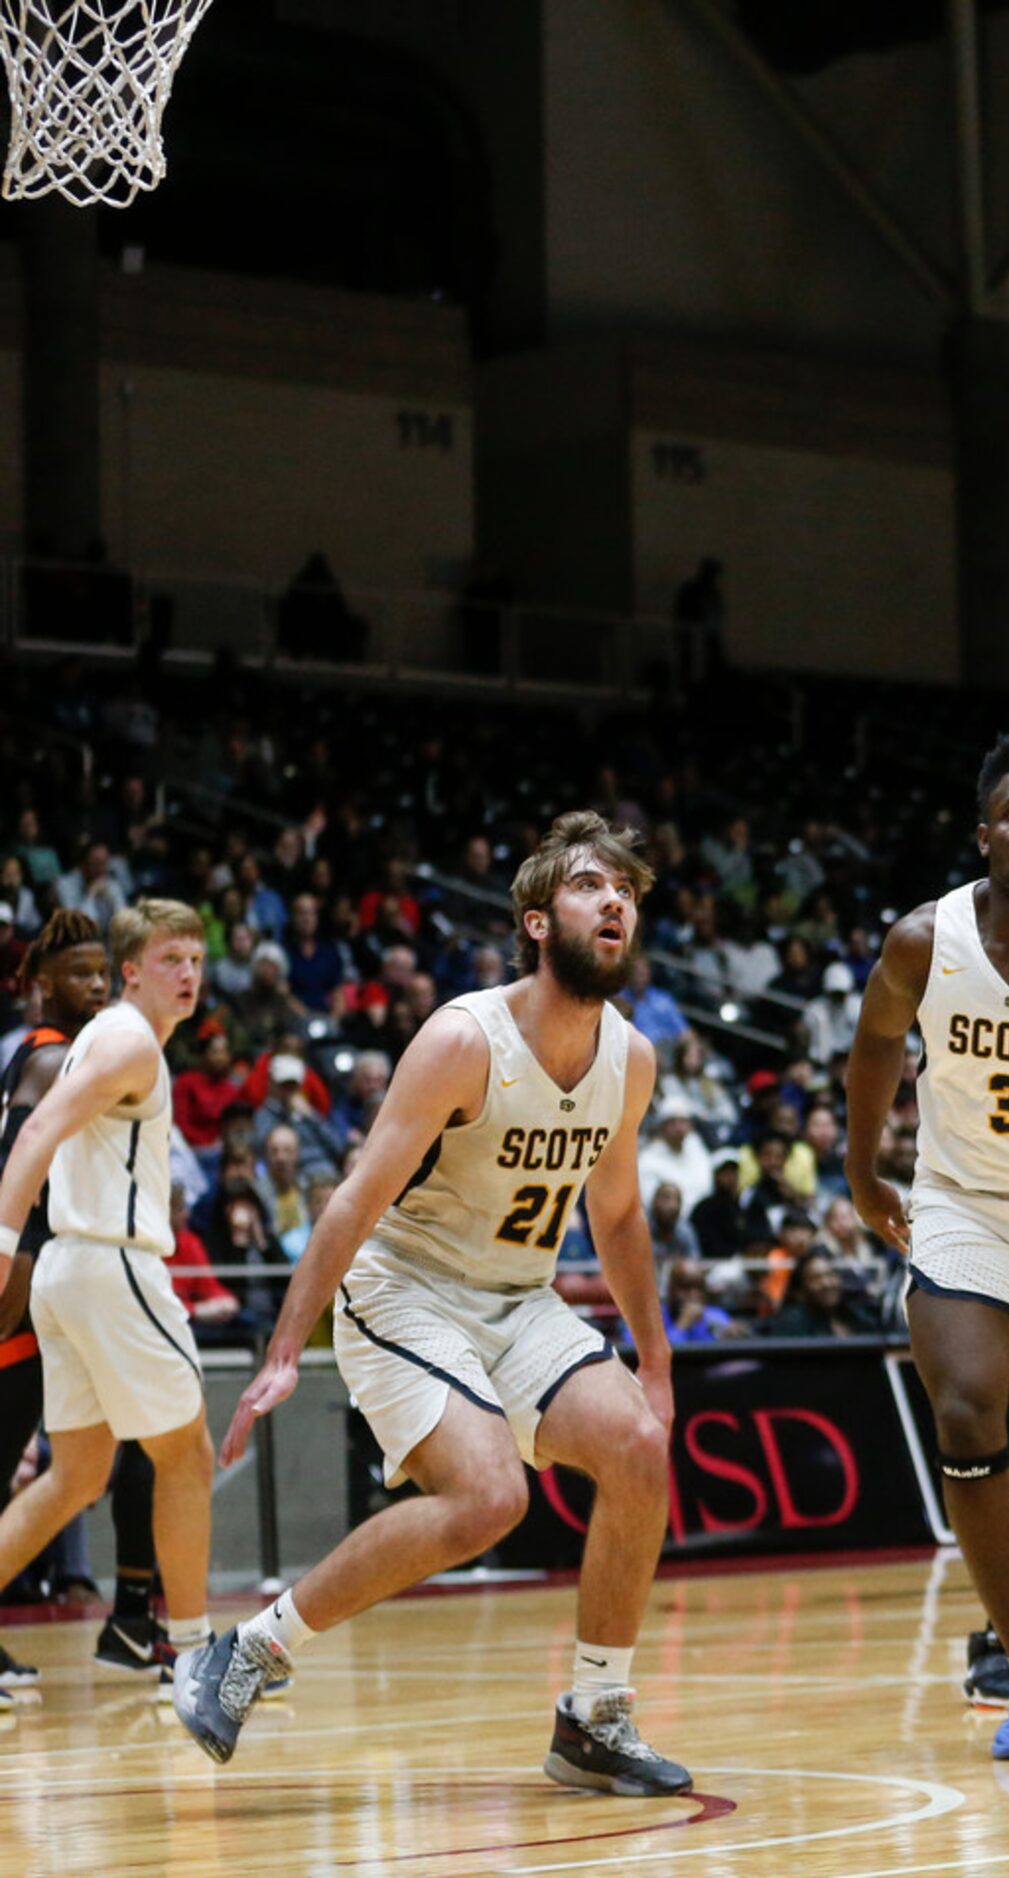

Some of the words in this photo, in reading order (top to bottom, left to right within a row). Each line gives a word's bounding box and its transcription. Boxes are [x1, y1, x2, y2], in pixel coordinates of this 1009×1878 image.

[496, 1126, 610, 1172] SCOTS
[494, 1182, 577, 1252] 21
[540, 1407, 859, 1546] ISD
